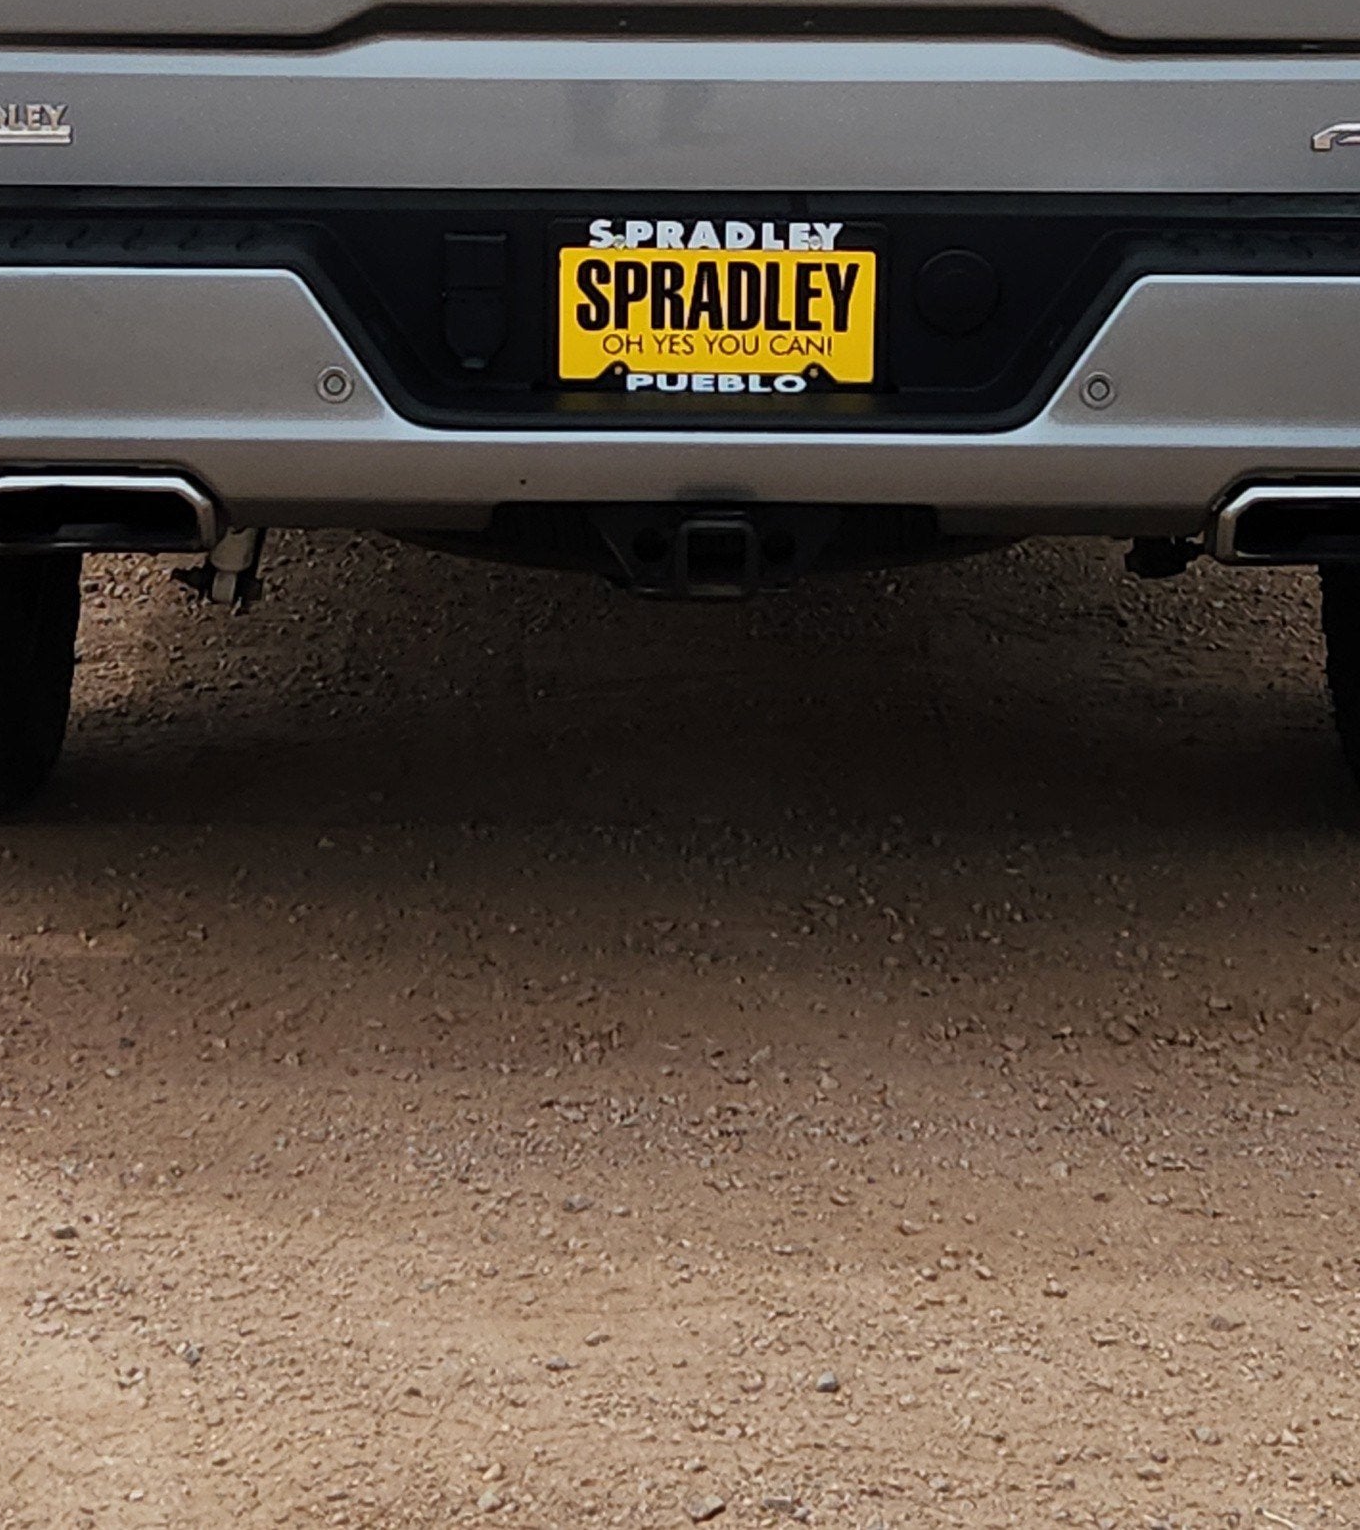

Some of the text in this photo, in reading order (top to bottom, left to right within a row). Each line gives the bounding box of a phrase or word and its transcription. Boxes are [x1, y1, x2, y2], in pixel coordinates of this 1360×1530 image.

[588, 219, 843, 252] SPRADLEY
[576, 258, 860, 333] SPRADLEY
[602, 334, 833, 357] OH YES YOU CAN!
[625, 373, 808, 394] PUEBLO
